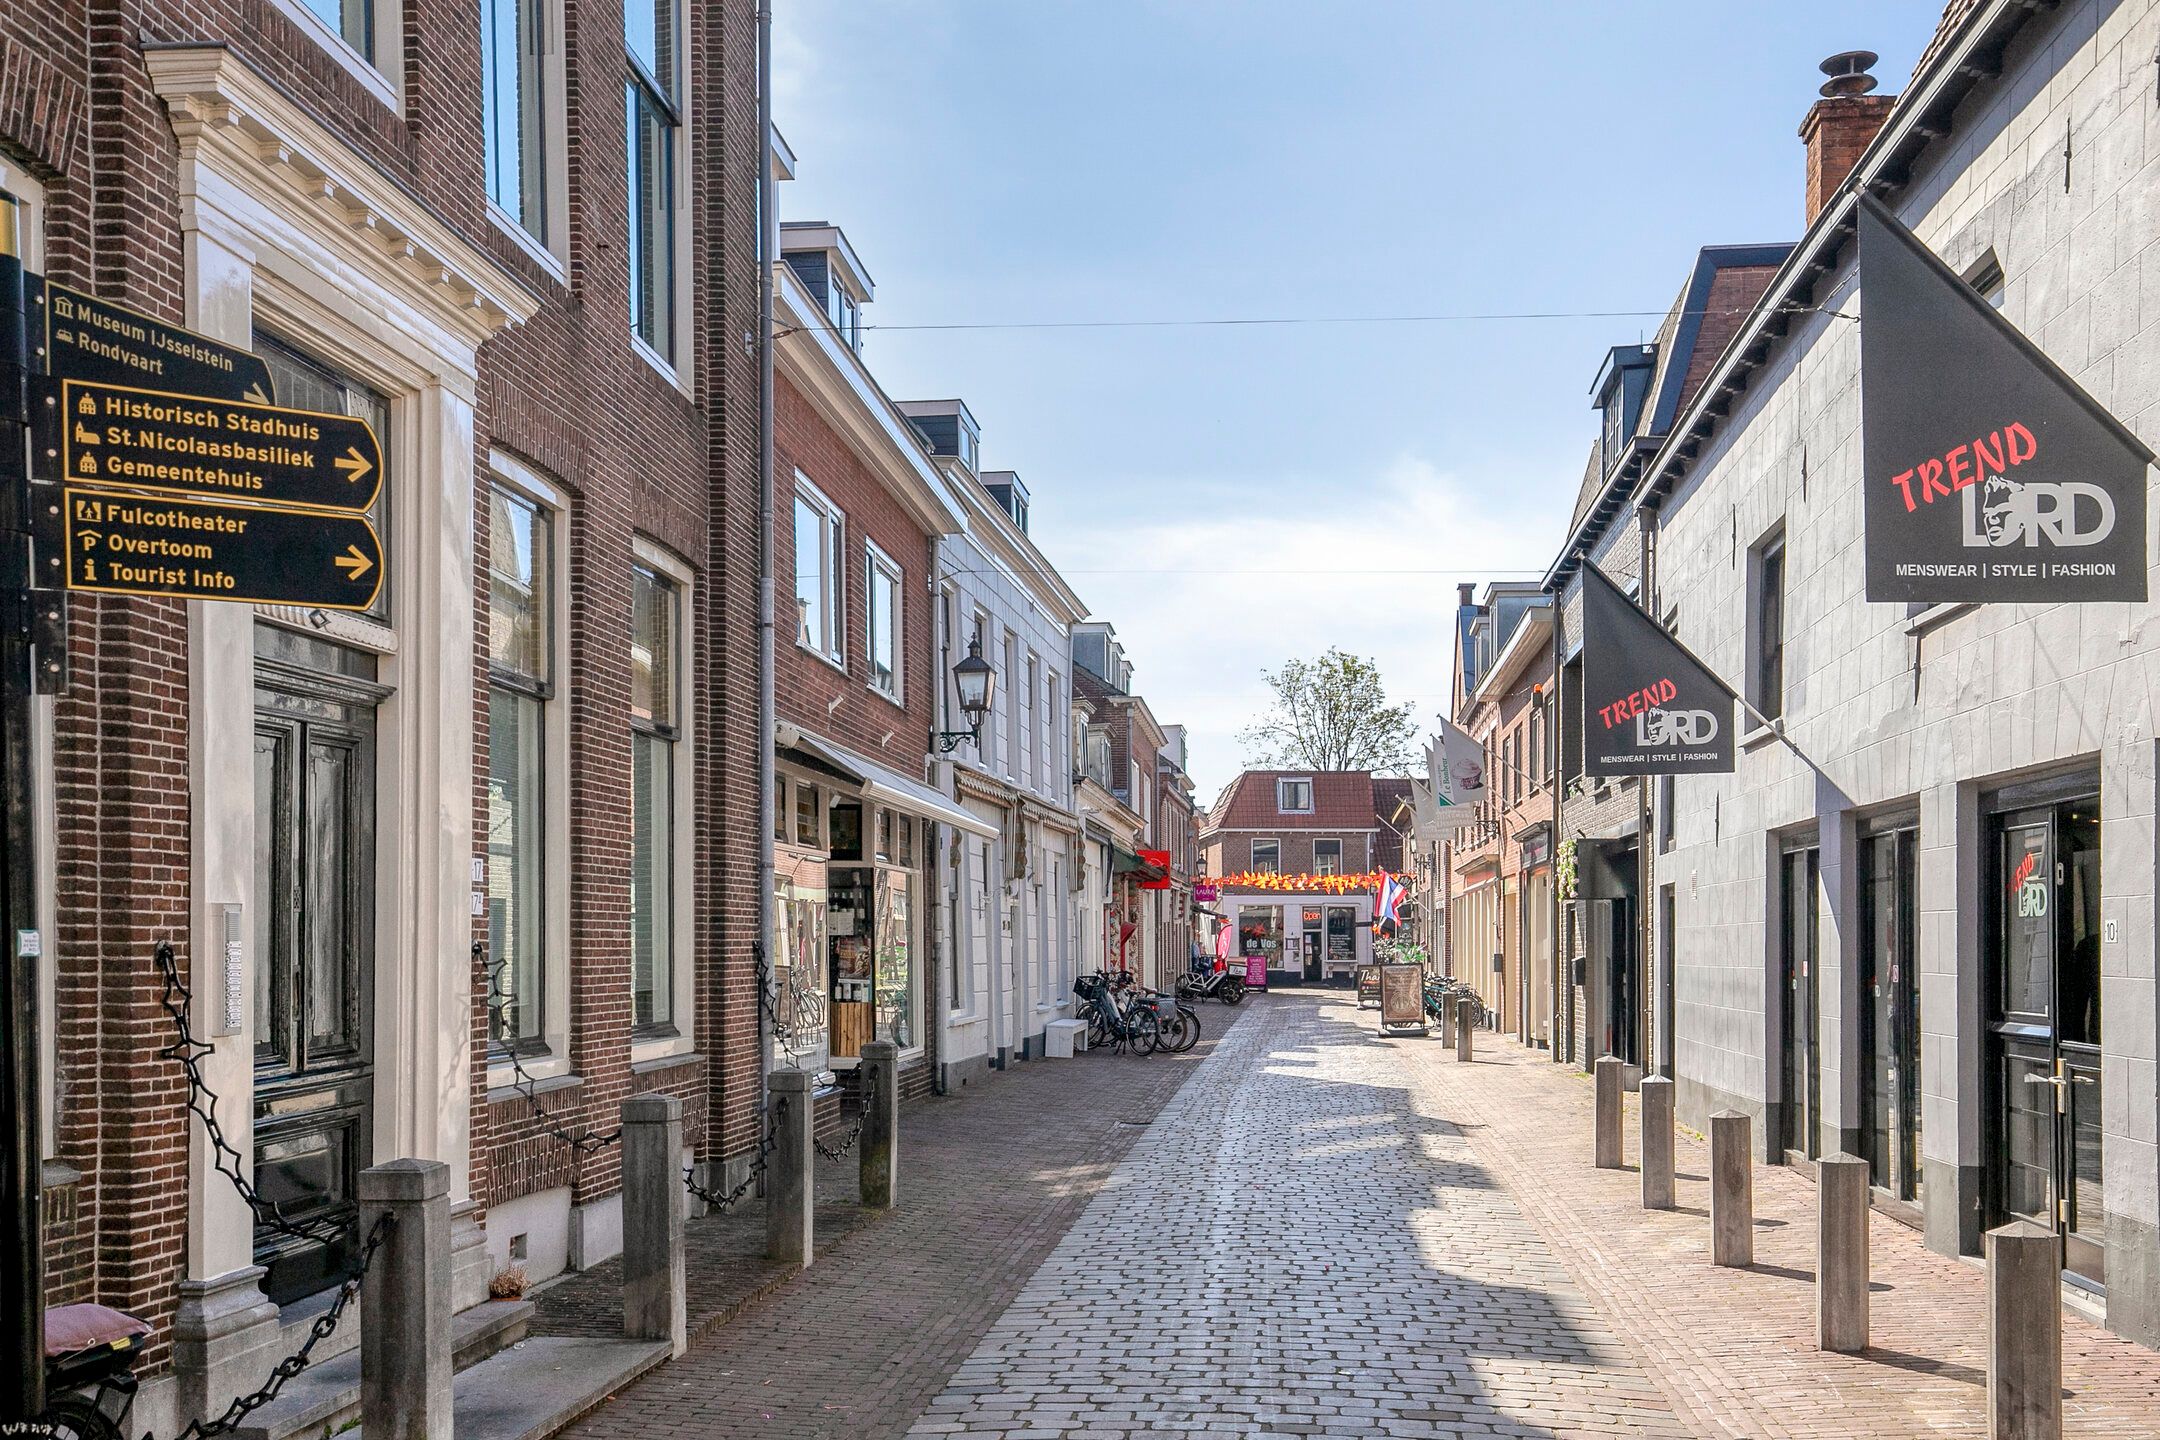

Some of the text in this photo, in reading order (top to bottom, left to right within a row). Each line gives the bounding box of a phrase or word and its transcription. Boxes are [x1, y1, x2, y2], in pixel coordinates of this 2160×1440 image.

[77, 303, 233, 373] Museum IJsselstein
[78, 332, 163, 375] Rondvaart
[105, 397, 320, 441] Historisch Stadhuis
[107, 427, 315, 468] St.Nicolaasbasiliek
[107, 456, 263, 490] Gemeentehuis
[1892, 422, 2037, 513] TREND
[107, 504, 248, 534] Fulcotheater
[1962, 477, 2116, 547] LORD
[108, 534, 213, 560] Overtoom
[109, 562, 187, 586] Tourist
[194, 569, 236, 590] Info
[1896, 564, 1977, 577] MENSWEAR
[1991, 564, 2037, 577] STYLE
[2052, 563, 2116, 577] FASHION
[1598, 678, 1677, 730] TREND
[1636, 708, 1718, 747] LORD
[1600, 755, 1645, 764] MENSWEAR
[1652, 753, 1677, 762] STYLE
[1683, 752, 1718, 761] FASHION
[474, 861, 481, 880] 17
[1303, 911, 1321, 921] Open
[2018, 882, 2047, 917] LORD
[1246, 938, 1277, 948] de Vos
[2107, 923, 2115, 941] 10
